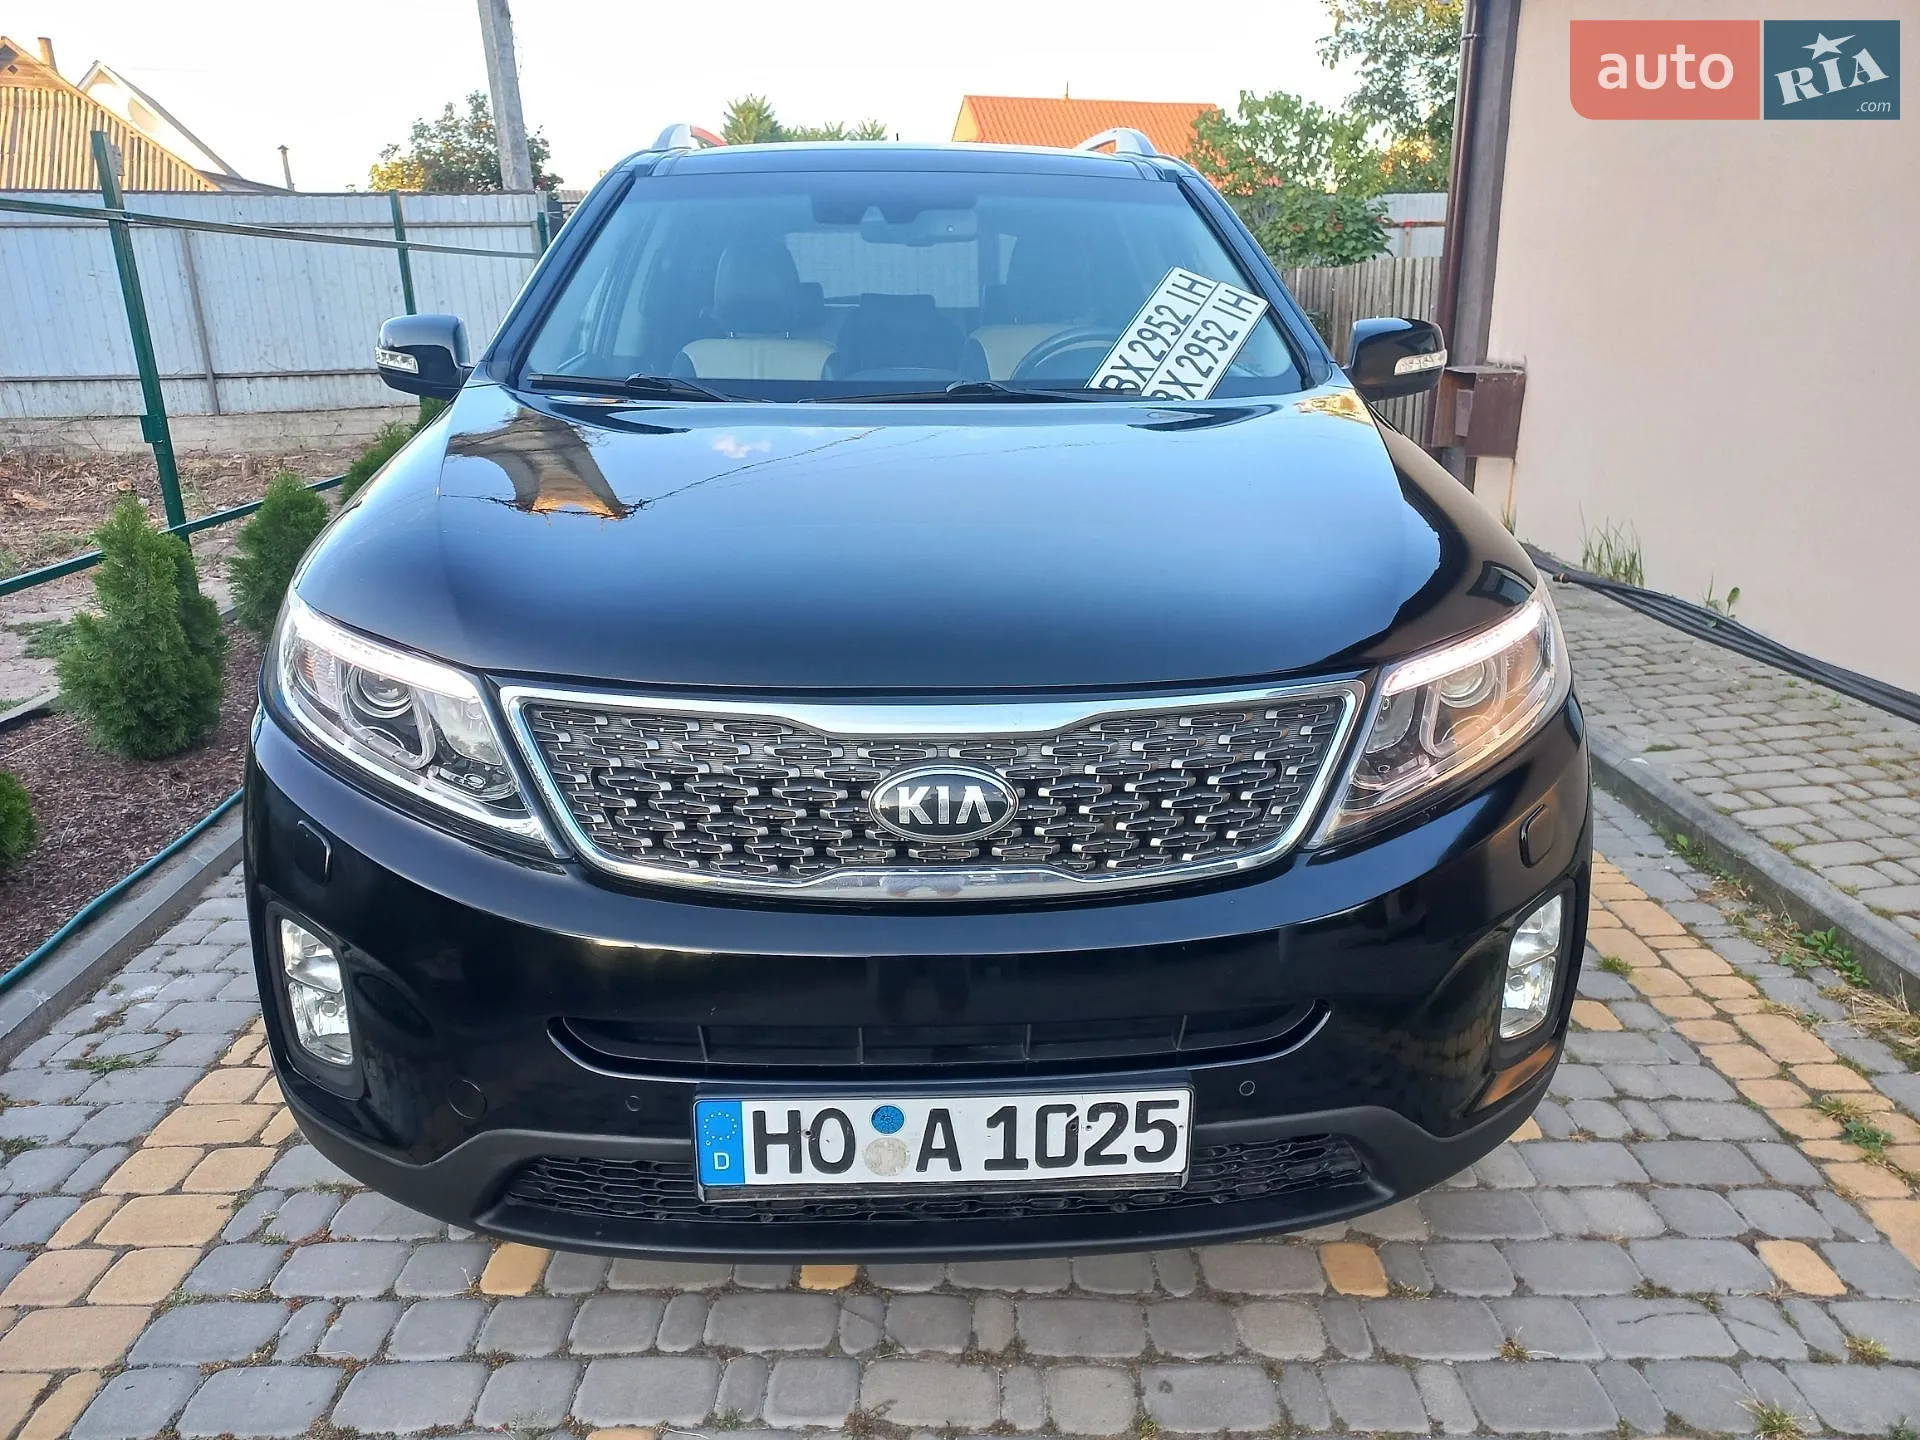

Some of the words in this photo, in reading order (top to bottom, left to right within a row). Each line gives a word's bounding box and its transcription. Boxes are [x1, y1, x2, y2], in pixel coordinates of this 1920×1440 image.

[1127, 304, 1192, 363] 2952
[1165, 273, 1213, 306] IH
[1175, 319, 1239, 379] 2952
[1212, 289, 1259, 322] IH
[896, 785, 993, 825] KIA
[713, 1151, 731, 1171] D
[752, 1107, 856, 1175] HO
[915, 1107, 962, 1173] A
[984, 1099, 1180, 1170] 1025
